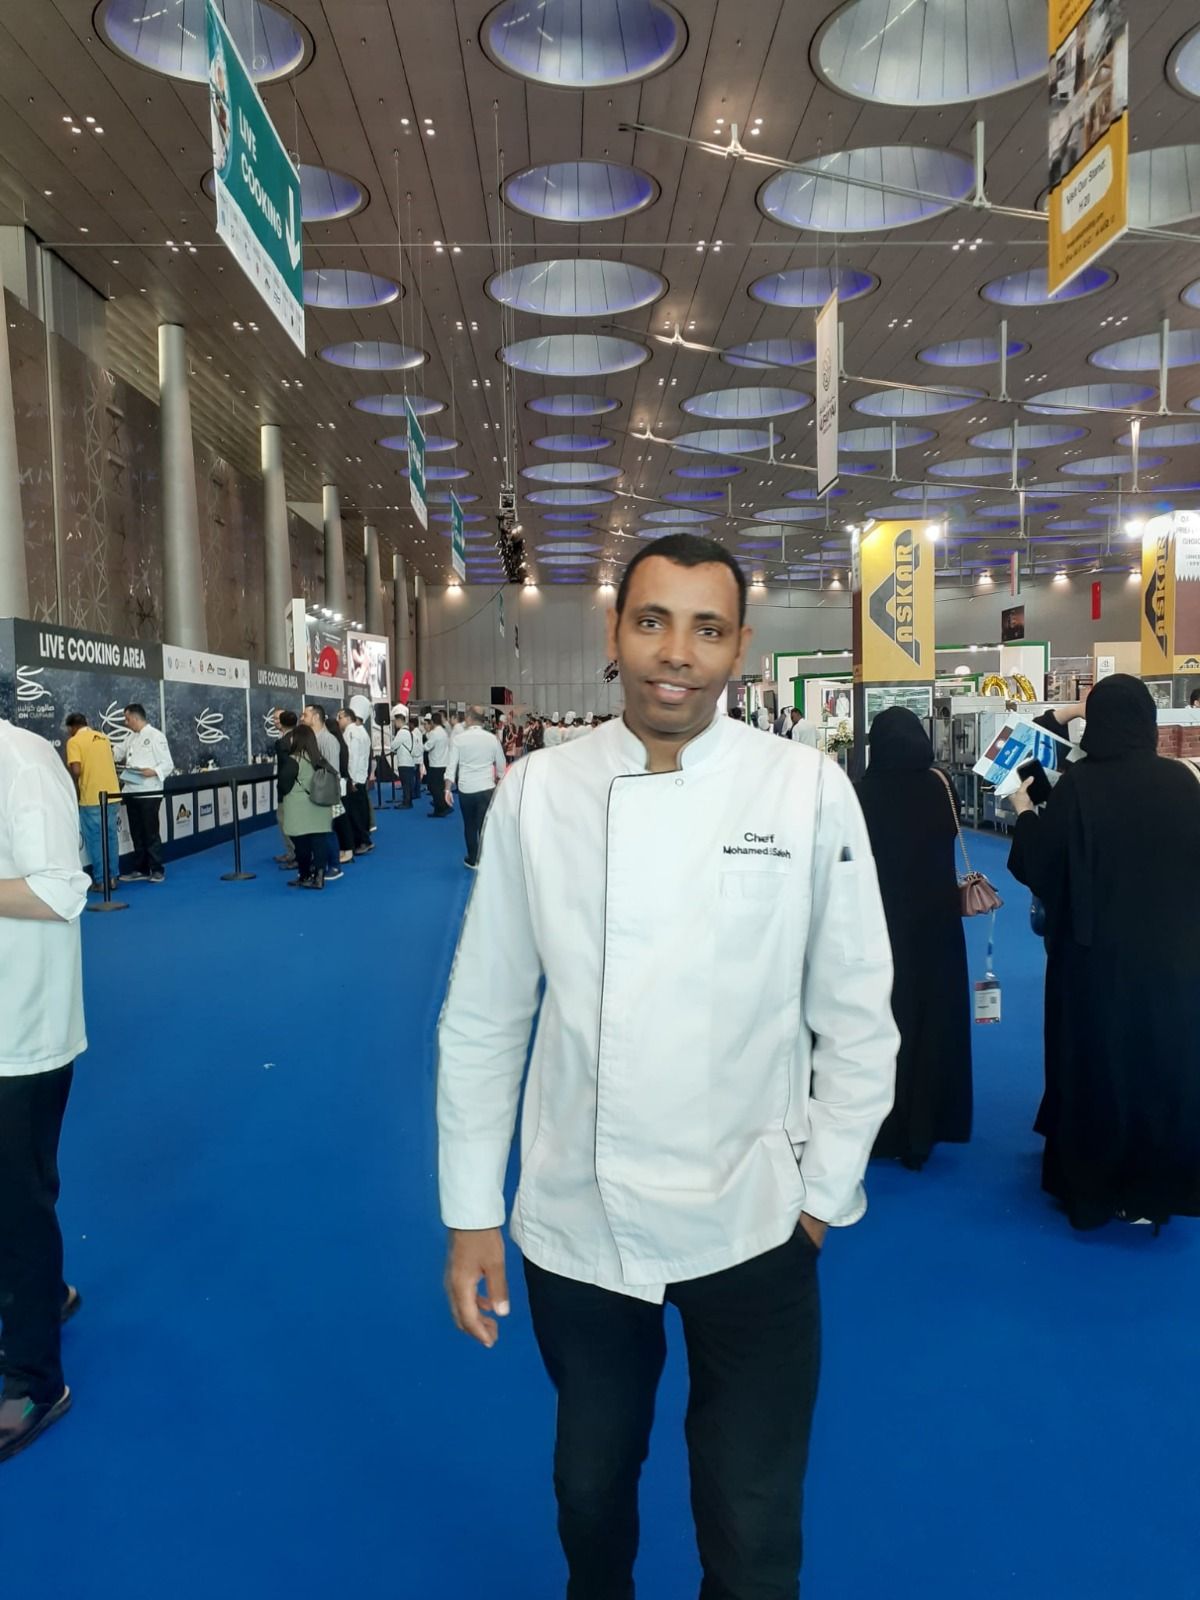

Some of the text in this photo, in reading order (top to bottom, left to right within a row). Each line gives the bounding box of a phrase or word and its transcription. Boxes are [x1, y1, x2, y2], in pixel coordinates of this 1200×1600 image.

[239, 105, 257, 162] LIVE
[241, 152, 282, 239] COOKING
[895, 543, 914, 643] ASKAR
[39, 632, 65, 660] LIVE
[67, 638, 120, 666] COOKING
[122, 646, 146, 670] AREA
[257, 669, 267, 685] LIVE
[267, 671, 288, 688] COOKING
[288, 674, 299, 689] AREA
[722, 845, 768, 856] Mohamed
[743, 831, 775, 844] Chef
